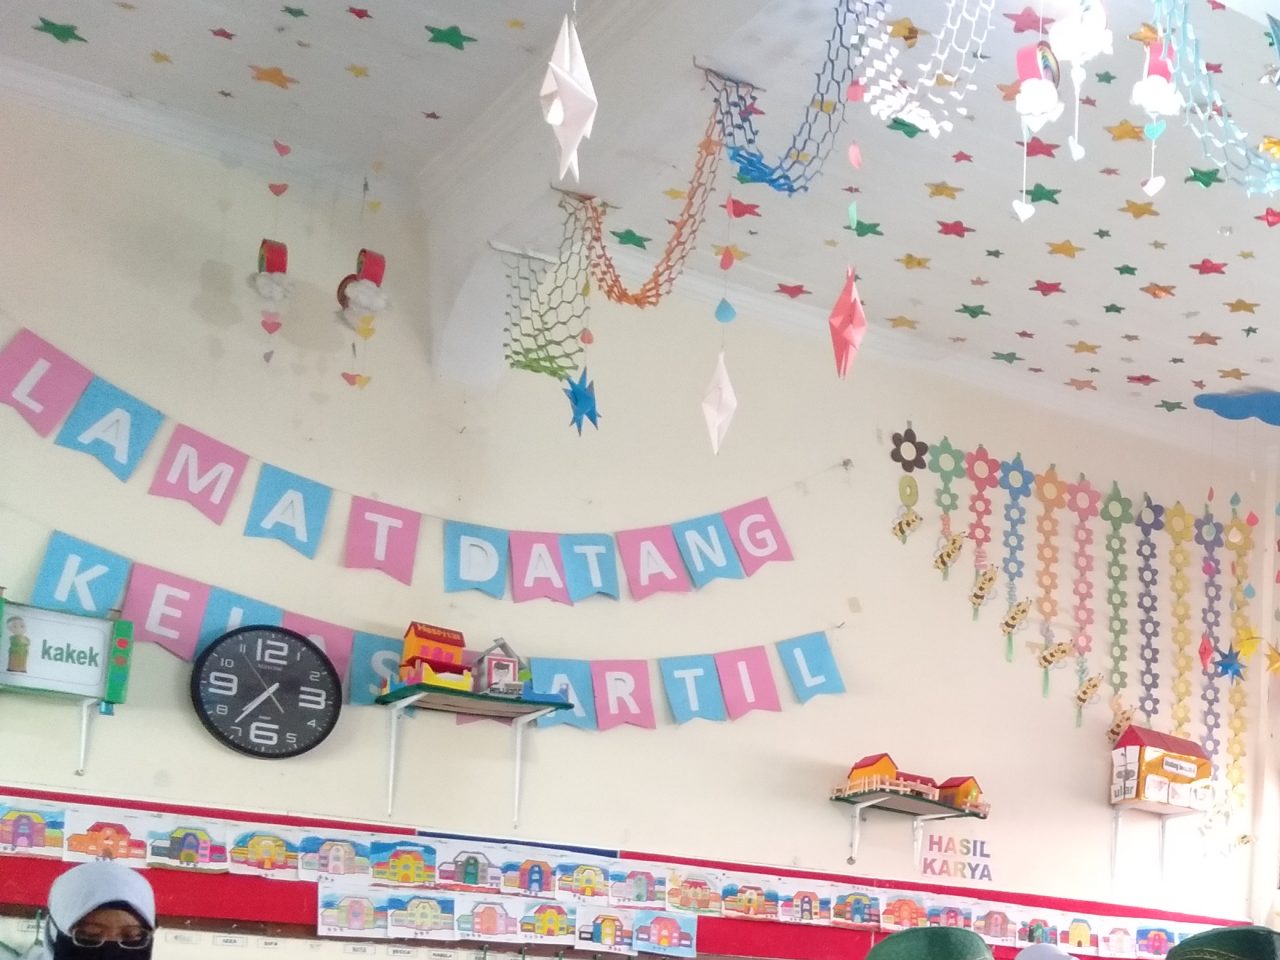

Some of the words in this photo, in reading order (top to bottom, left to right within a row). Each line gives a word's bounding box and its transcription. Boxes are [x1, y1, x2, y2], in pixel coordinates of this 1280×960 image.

[459, 513, 779, 588] DATANG
[40, 639, 99, 669] kakek
[220, 657, 234, 668] 10
[256, 638, 289, 665] 12
[208, 671, 239, 696] 9
[309, 671, 321, 681] 2
[216, 704, 228, 715] 8
[299, 686, 327, 710] 3
[230, 726, 242, 736] 7
[250, 721, 279, 746] 6
[306, 719, 316, 728] 4
[286, 732, 297, 743] 5
[1114, 784, 1134, 799] ular
[928, 834, 991, 859] HASIL
[922, 856, 993, 882] KARYA
